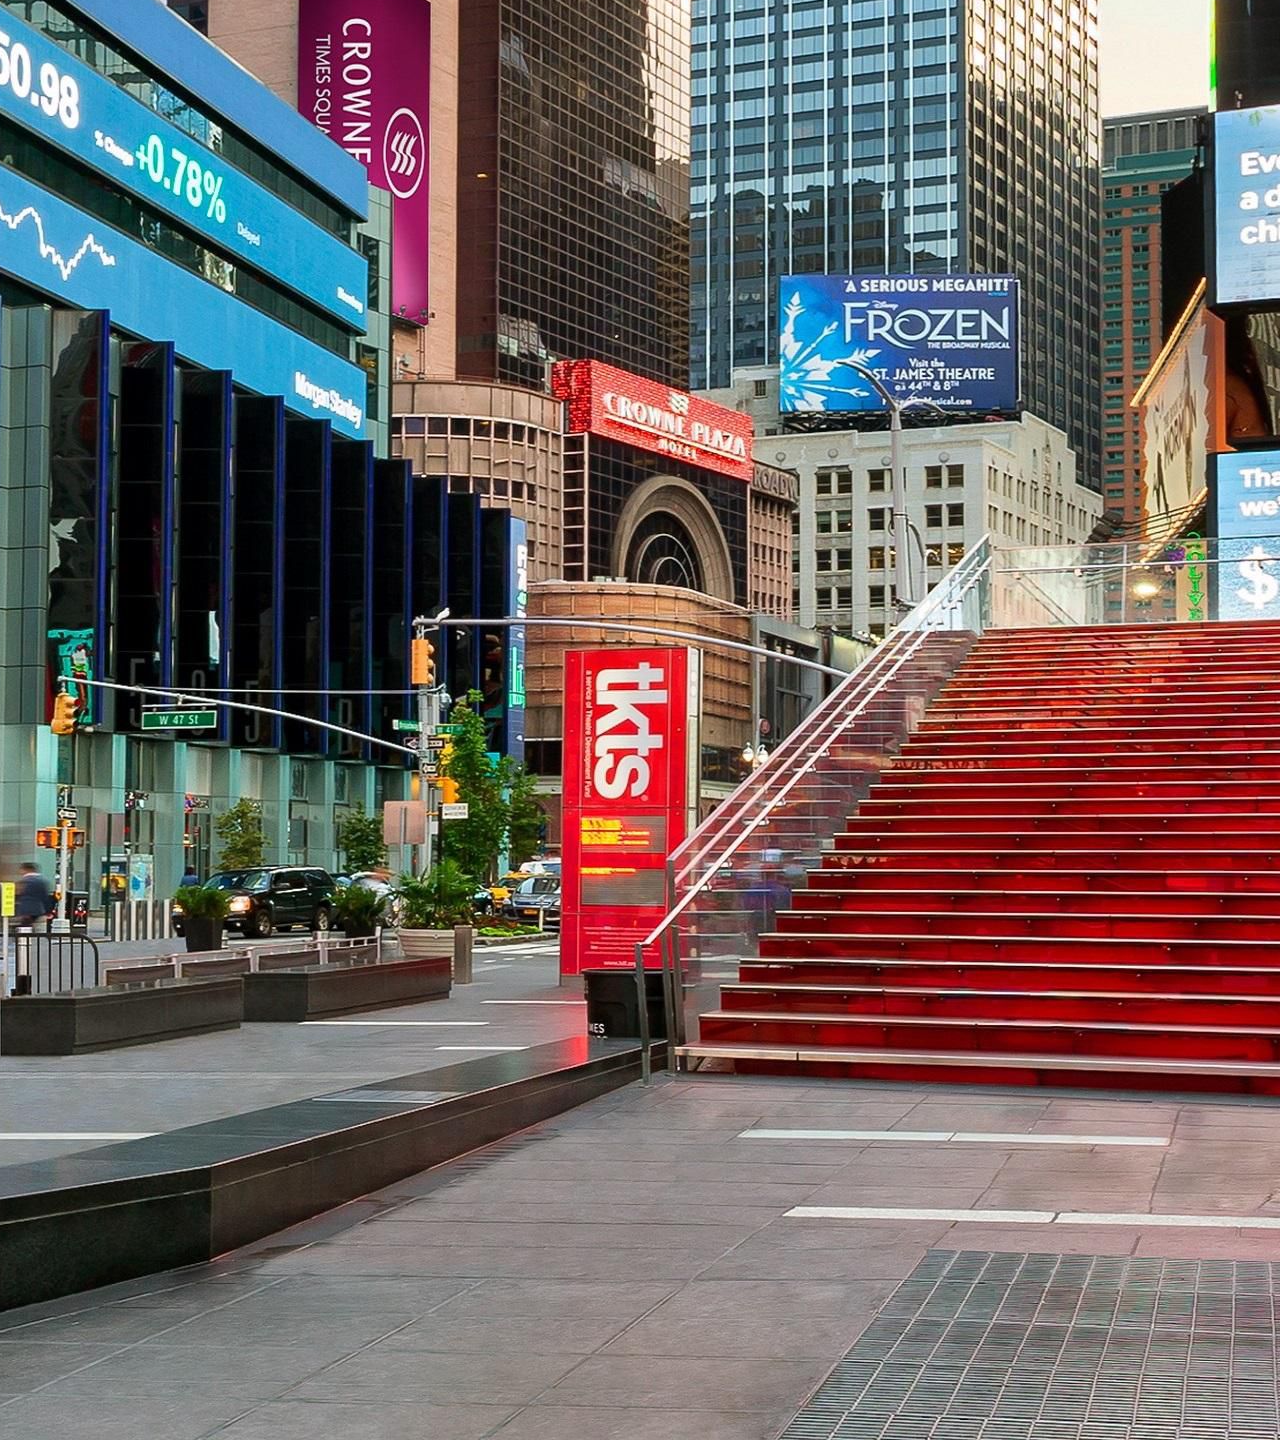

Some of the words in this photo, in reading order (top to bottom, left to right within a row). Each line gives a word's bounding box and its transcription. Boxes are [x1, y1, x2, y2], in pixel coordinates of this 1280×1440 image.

[315, 34, 331, 84] TIMES
[136, 134, 226, 223] +0.78%
[1239, 193, 1258, 210] a
[860, 279, 928, 292] SERIOUS
[842, 301, 1010, 349] FROZEN
[874, 368, 890, 380] ST.
[893, 368, 934, 381] JAMES
[938, 368, 996, 380] THEATRE
[908, 358, 929, 368] Visit
[931, 358, 945, 368] the
[933, 382, 942, 391] &
[295, 371, 330, 409] Morgan
[329, 390, 362, 429] Stanley
[602, 392, 688, 437] CROWNE
[691, 421, 746, 457] PLAZA
[658, 439, 698, 460] HOTEL
[160, 715, 169, 725] W
[172, 714, 184, 725] 47
[188, 714, 199, 725] St
[585, 710, 593, 735] Theatre
[594, 662, 668, 800] tkts
[584, 737, 592, 779] Development
[584, 780, 592, 798] Fund
